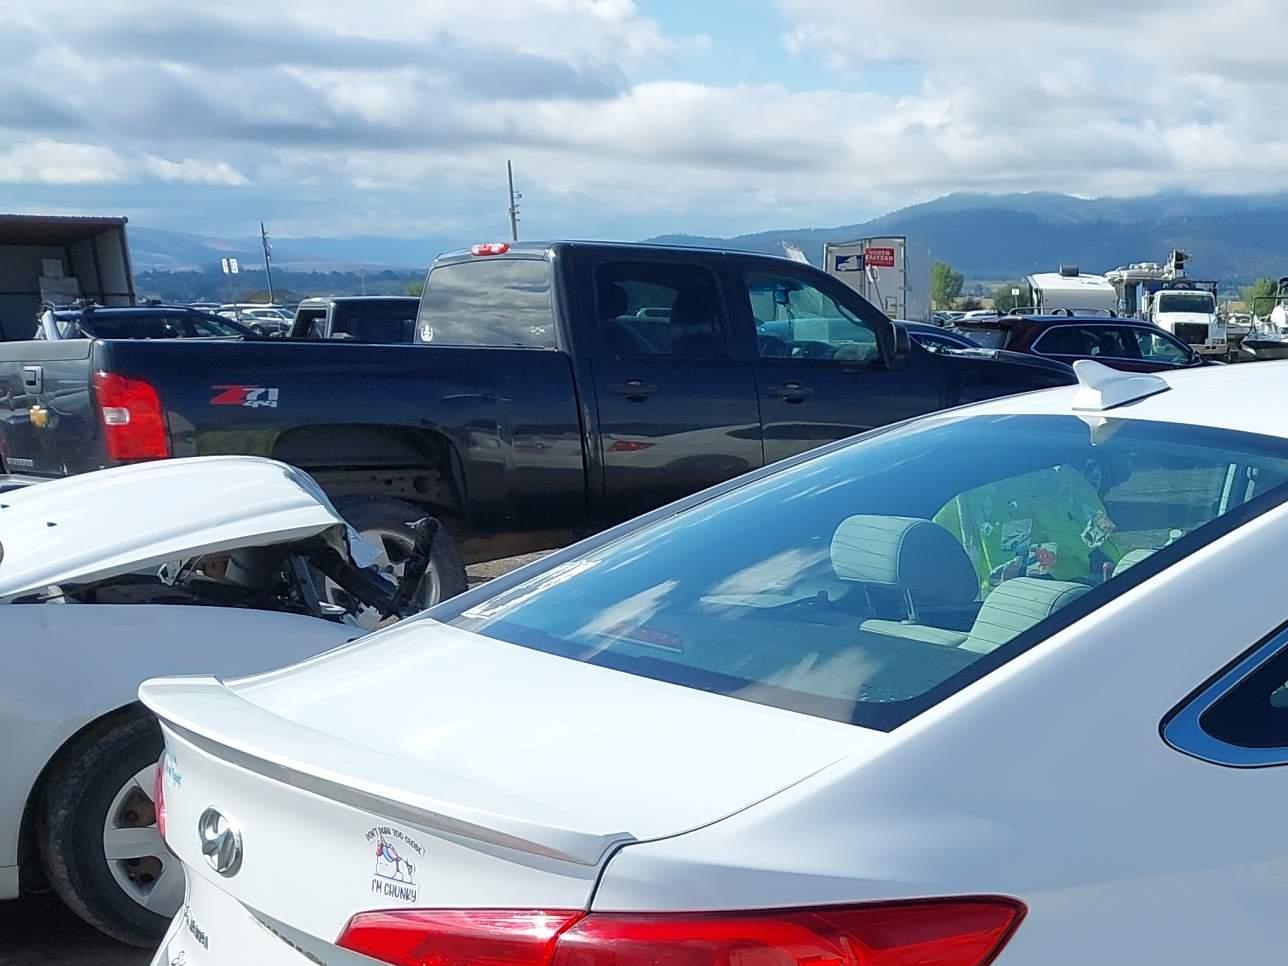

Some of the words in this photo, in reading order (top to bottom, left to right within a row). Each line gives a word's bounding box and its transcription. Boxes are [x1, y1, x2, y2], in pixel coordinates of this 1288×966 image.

[209, 384, 279, 405] Z71
[391, 828, 404, 840] TOO
[371, 879, 382, 894] I'M
[384, 883, 417, 903] CHUNKY
